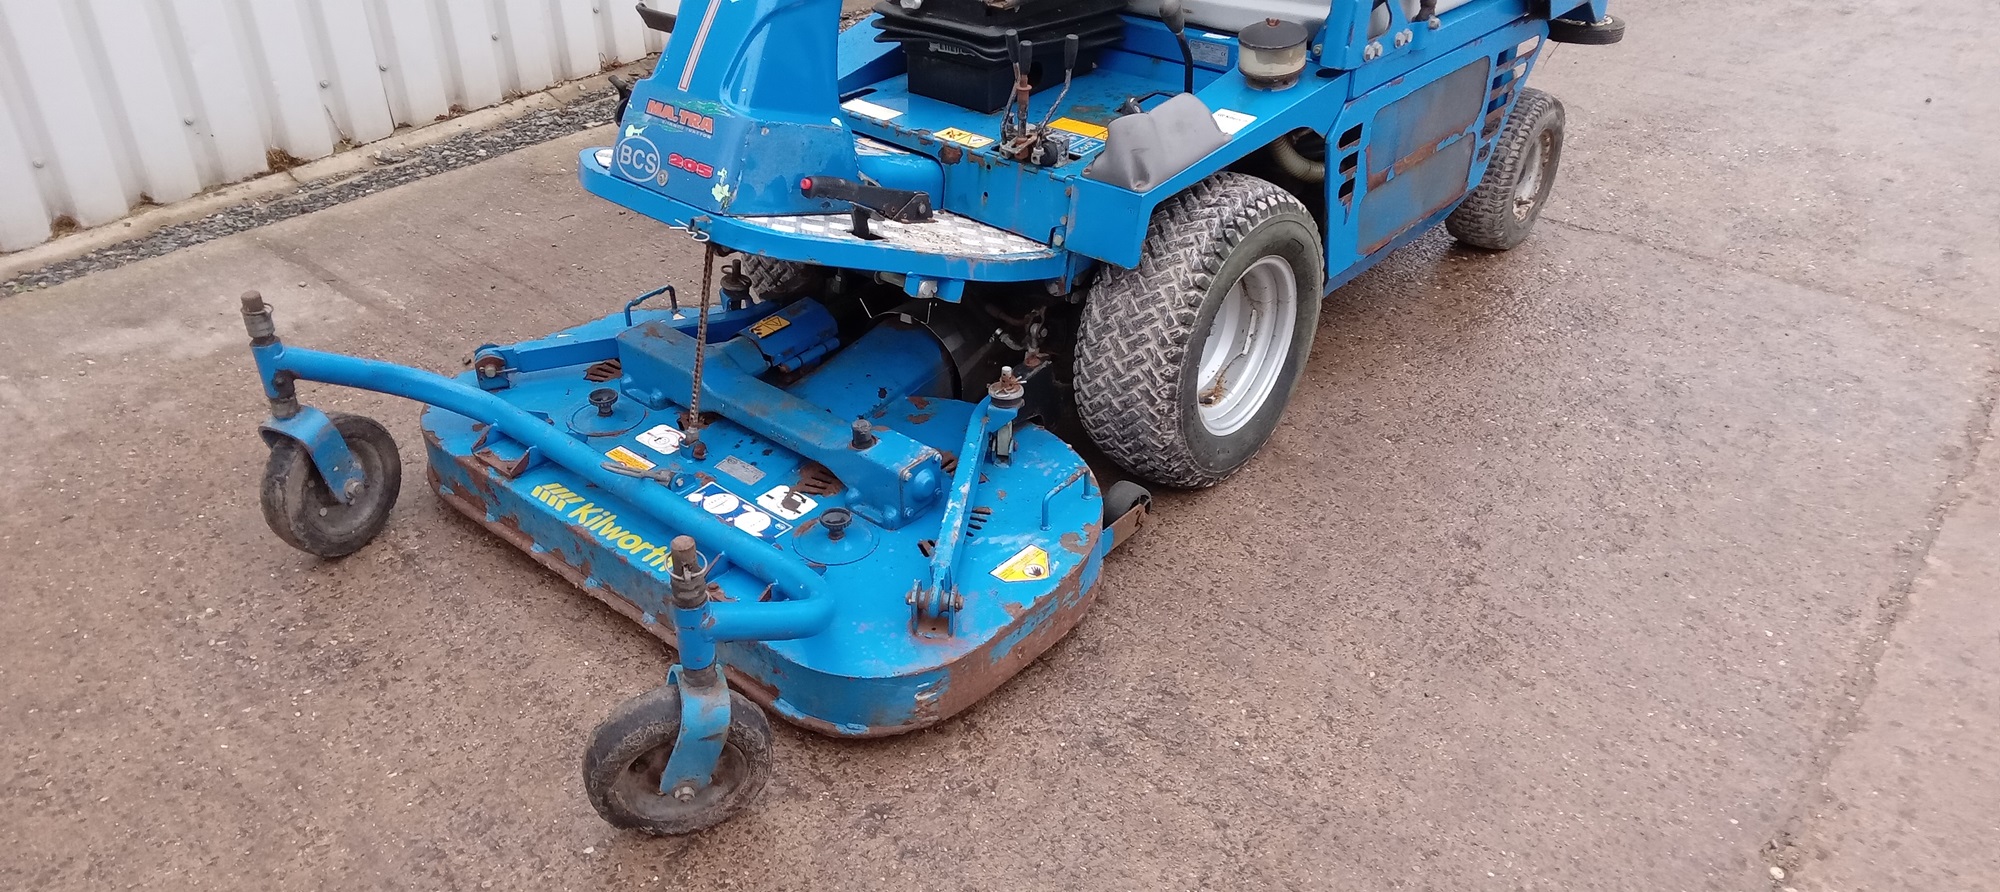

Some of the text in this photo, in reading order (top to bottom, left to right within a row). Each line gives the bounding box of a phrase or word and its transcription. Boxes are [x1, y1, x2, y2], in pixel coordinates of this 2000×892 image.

[645, 99, 714, 135] MA.TRA
[620, 144, 657, 174] BCS
[668, 152, 714, 179] 205
[567, 502, 673, 572] Kilworth
